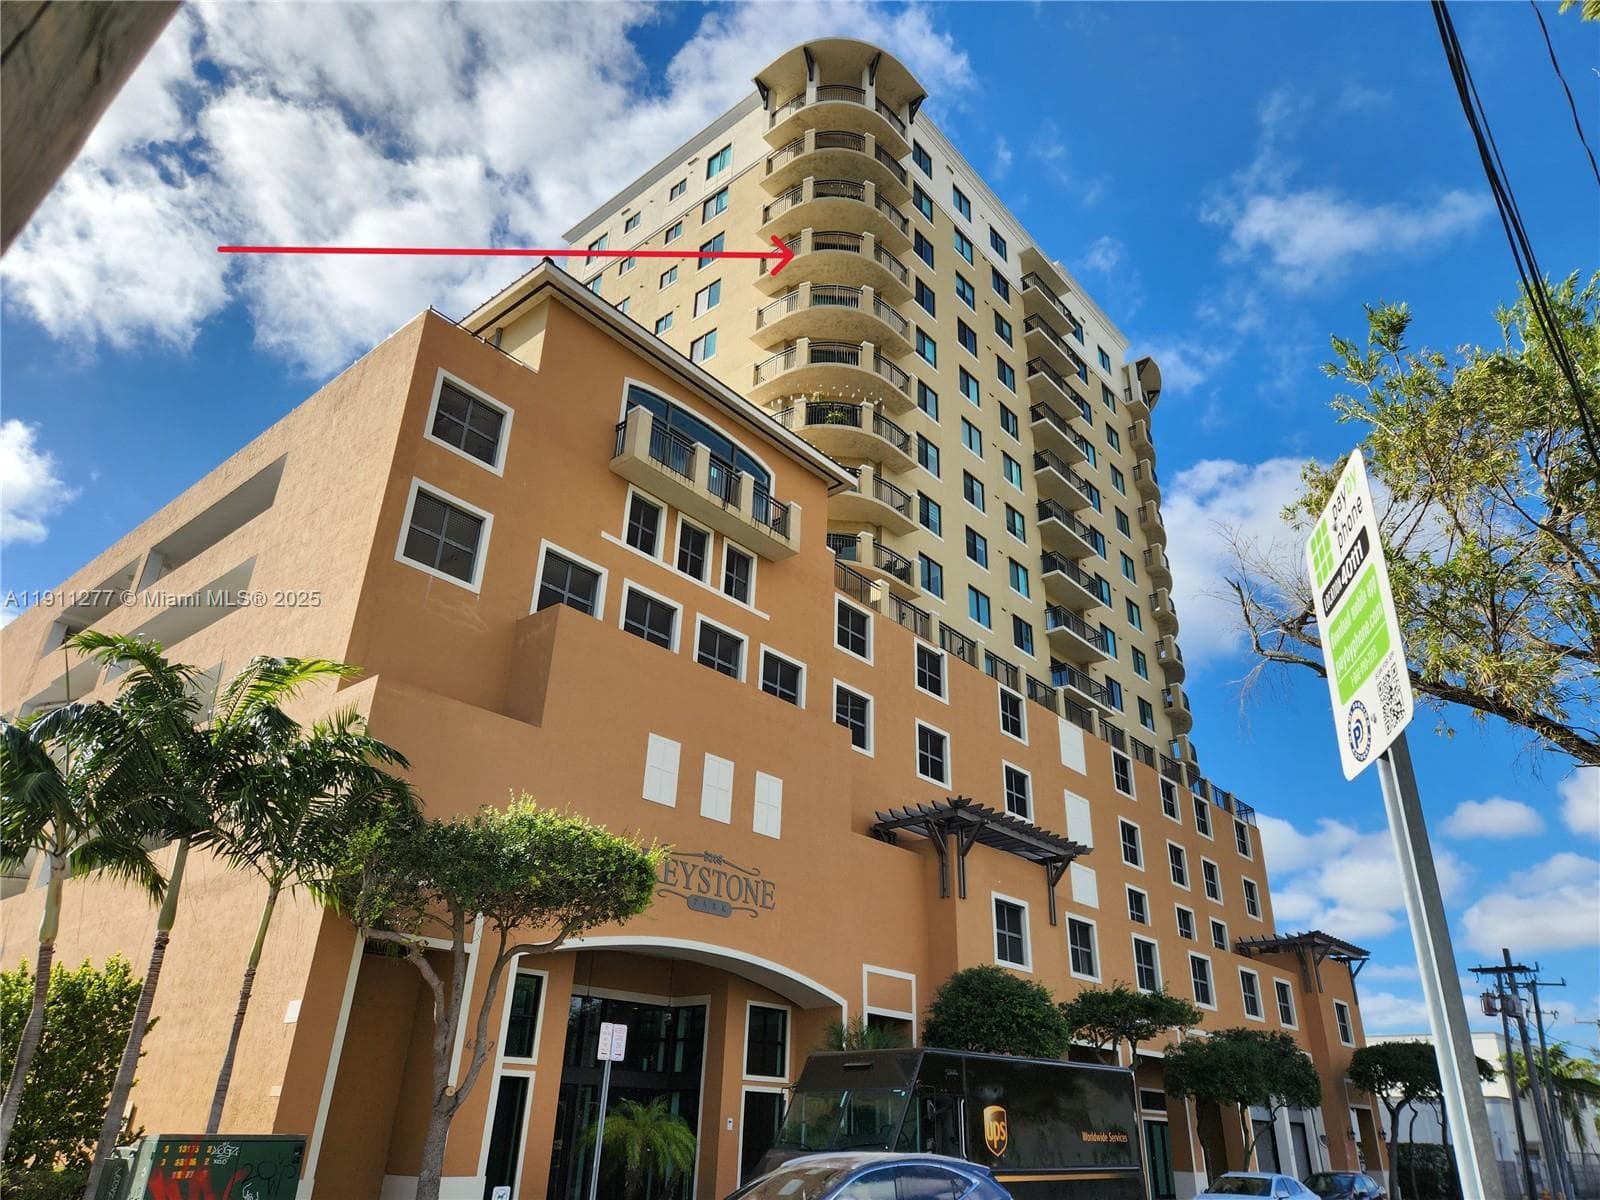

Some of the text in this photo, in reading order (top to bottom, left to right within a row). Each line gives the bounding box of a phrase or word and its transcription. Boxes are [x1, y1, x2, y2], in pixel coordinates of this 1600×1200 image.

[1338, 496, 1363, 556] phone
[1323, 539, 1364, 612] LOCATION 40111
[1335, 602, 1384, 678] paybyphone.com
[648, 855, 776, 910] EYSTONE
[987, 1121, 1006, 1149] ups
[1081, 1131, 1128, 1142] Worldwide Services
